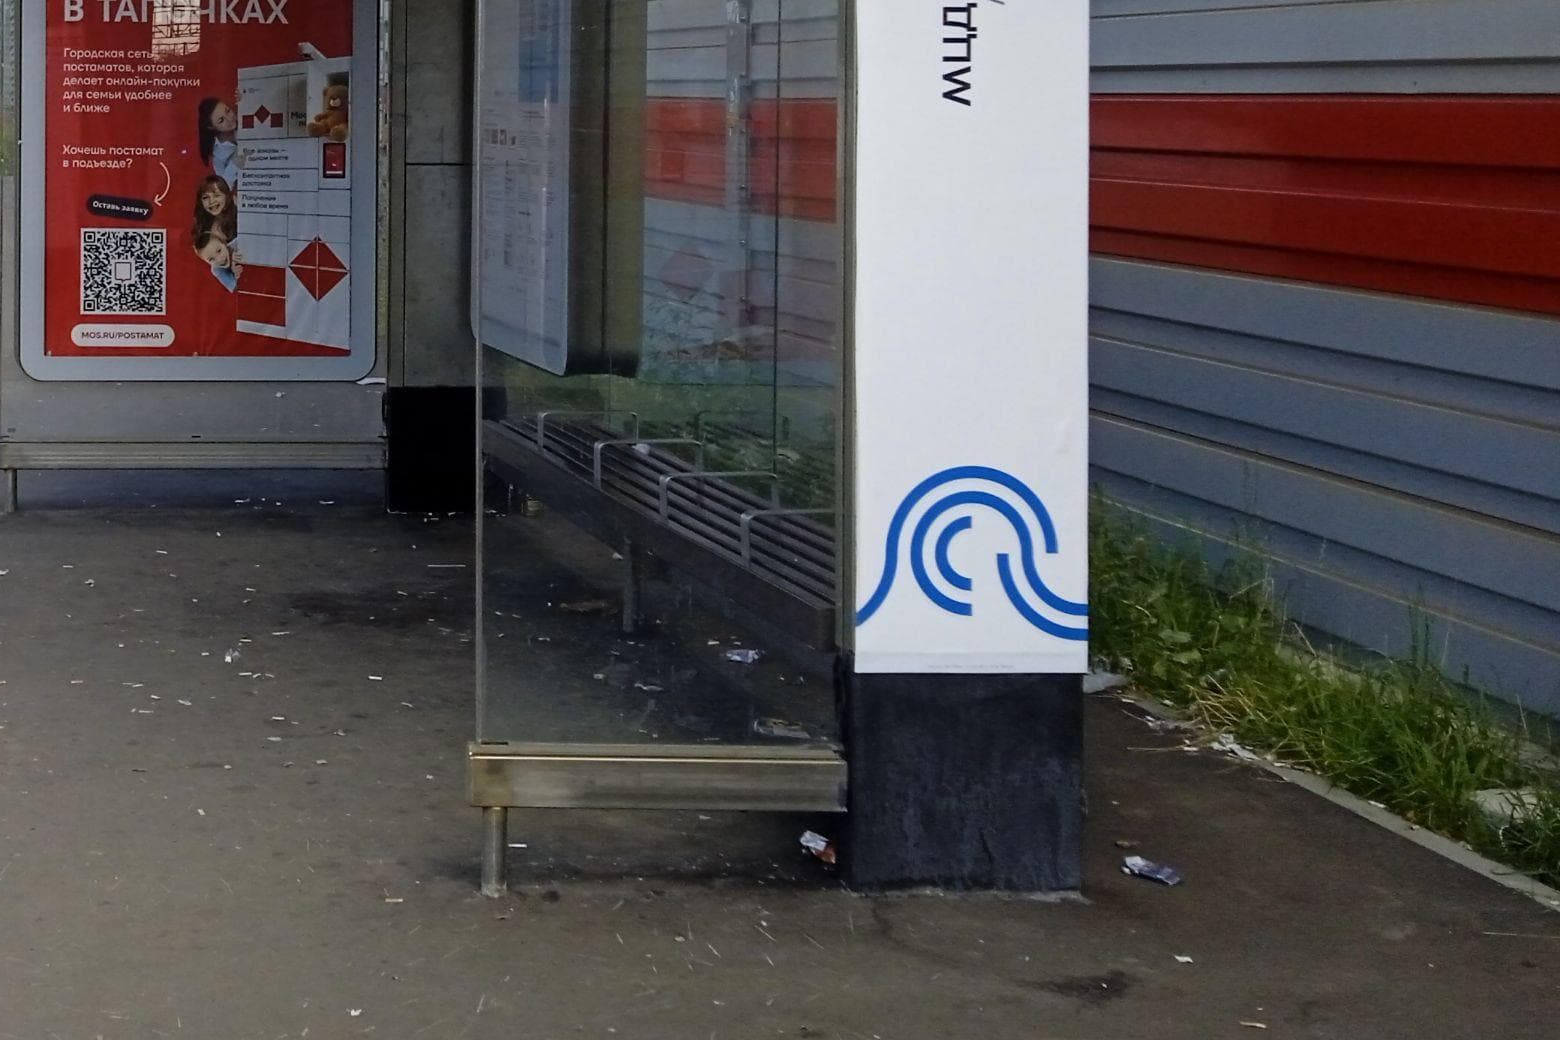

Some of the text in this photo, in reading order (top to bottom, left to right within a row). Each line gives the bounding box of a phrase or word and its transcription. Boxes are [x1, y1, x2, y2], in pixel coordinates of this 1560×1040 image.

[63, 47, 154, 59] Городская сеть
[942, 3, 977, 107] МЦД
[63, 63, 185, 74] постаматов, которая
[63, 76, 200, 88] делает онлайн-покупки
[63, 90, 172, 101] для семьи удобнее
[63, 103, 110, 113] и ближе
[62, 145, 164, 156] Хочешь постамат
[62, 158, 133, 168] в подъезде?
[92, 200, 149, 215] Оставь заявку
[81, 331, 165, 340] MOS.RU/POSTAMAT
